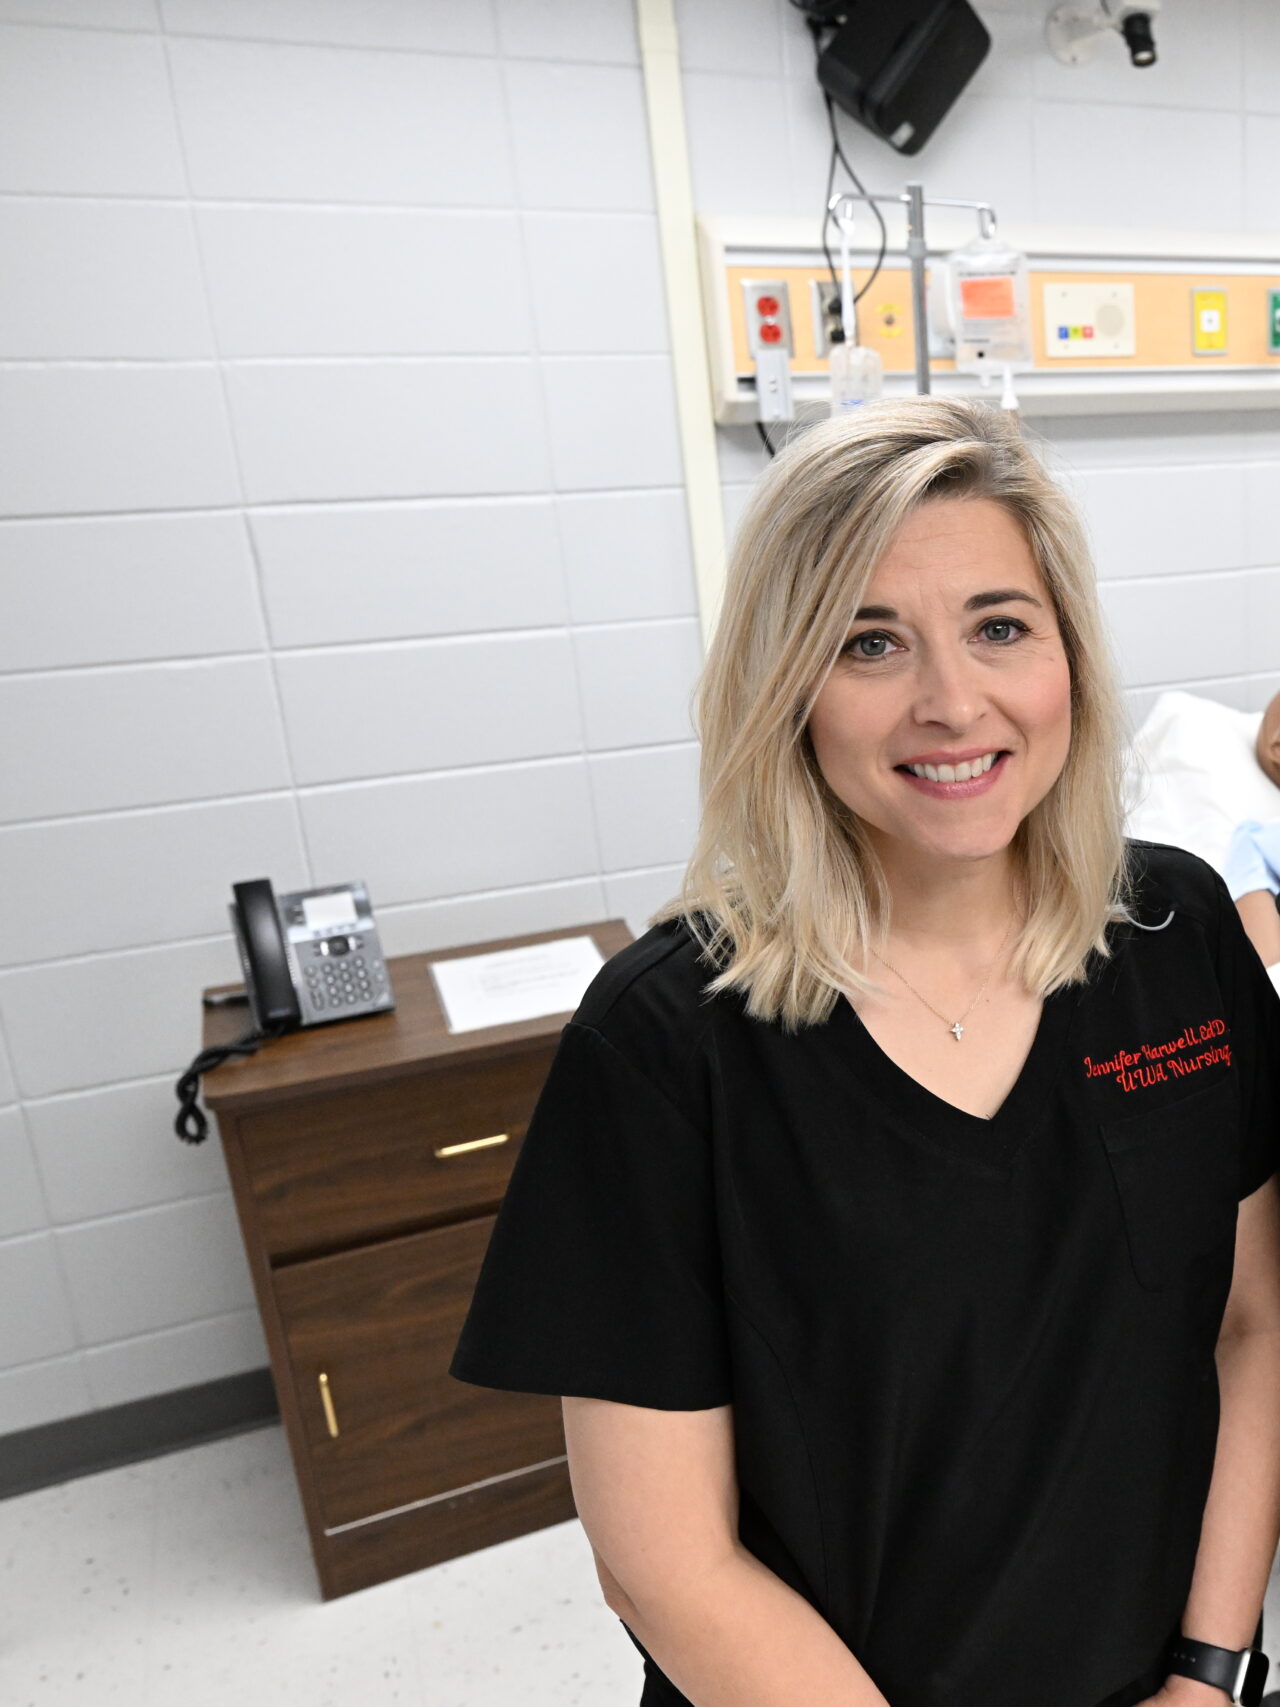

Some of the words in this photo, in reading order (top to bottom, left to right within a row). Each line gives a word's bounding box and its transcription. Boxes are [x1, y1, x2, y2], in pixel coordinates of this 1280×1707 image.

[1083, 1050, 1142, 1078] Jennifer
[1116, 1063, 1168, 1092] UWA
[1166, 1044, 1232, 1078] Nursing
